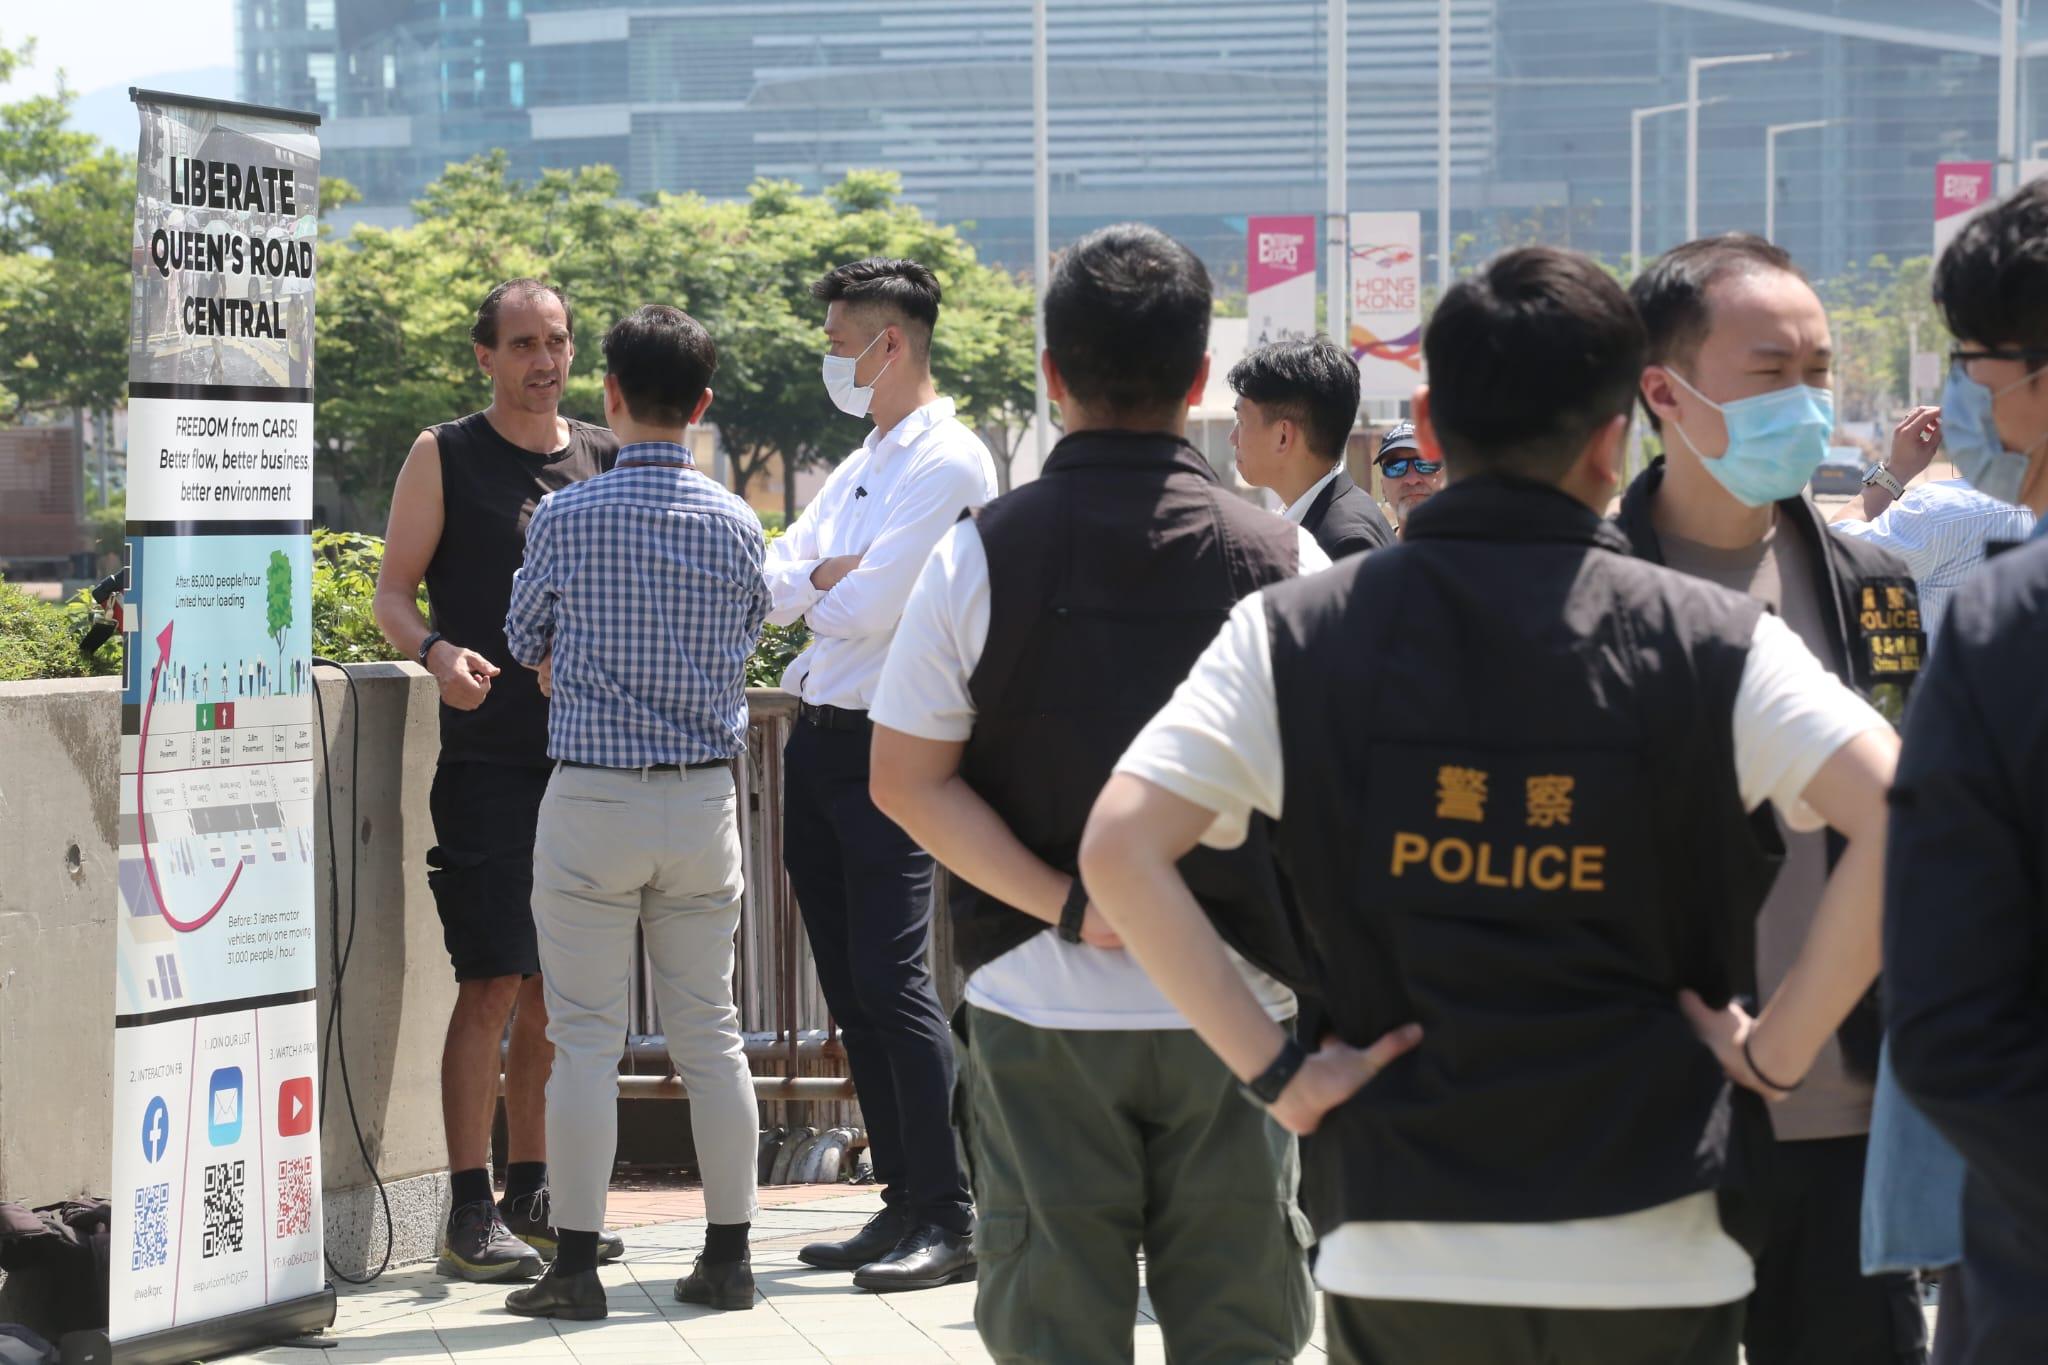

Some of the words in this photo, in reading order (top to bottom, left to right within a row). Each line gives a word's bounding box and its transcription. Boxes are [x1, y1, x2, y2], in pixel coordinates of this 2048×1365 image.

[170, 156, 296, 216] LIBERATE
[151, 228, 245, 277] QUEEN'S
[250, 237, 313, 279] ROAD
[1356, 277, 1415, 292] HONG
[1356, 295, 1415, 309] KONG
[183, 295, 287, 339] CENTRAL
[176, 416, 228, 437] FREEDOM
[231, 416, 259, 437] from
[262, 418, 298, 438] CARS!
[159, 448, 190, 469] Better
[192, 448, 218, 472] flow,
[222, 448, 257, 469] better
[260, 448, 310, 473] business,
[180, 480, 211, 501] better
[214, 480, 291, 501] environment
[176, 575, 190, 588] After:
[216, 572, 261, 590] people/hour
[175, 594, 196, 608] Limited
[198, 594, 215, 607] hour
[217, 592, 245, 609] loading
[1860, 610, 1919, 630] OLICE
[1436, 764, 1575, 827] 警察
[1391, 832, 1606, 891] POLICE
[228, 914, 252, 928] Before:
[253, 913, 258, 925] 3
[259, 911, 277, 925] lanes
[279, 909, 299, 922] motor
[228, 931, 256, 946] vehicles,
[257, 929, 273, 944] only
[274, 930, 288, 941] one
[289, 926, 311, 940] moving
[250, 947, 274, 963] people
[280, 945, 296, 958] hour
[210, 1036, 224, 1050] JOIN
[224, 1033, 238, 1048] OUR
[239, 1032, 251, 1045] LIST
[276, 1044, 298, 1059] WATCH
[138, 1065, 165, 1081] INTERACT
[166, 1063, 175, 1077] ON
[175, 1062, 182, 1075] FB
